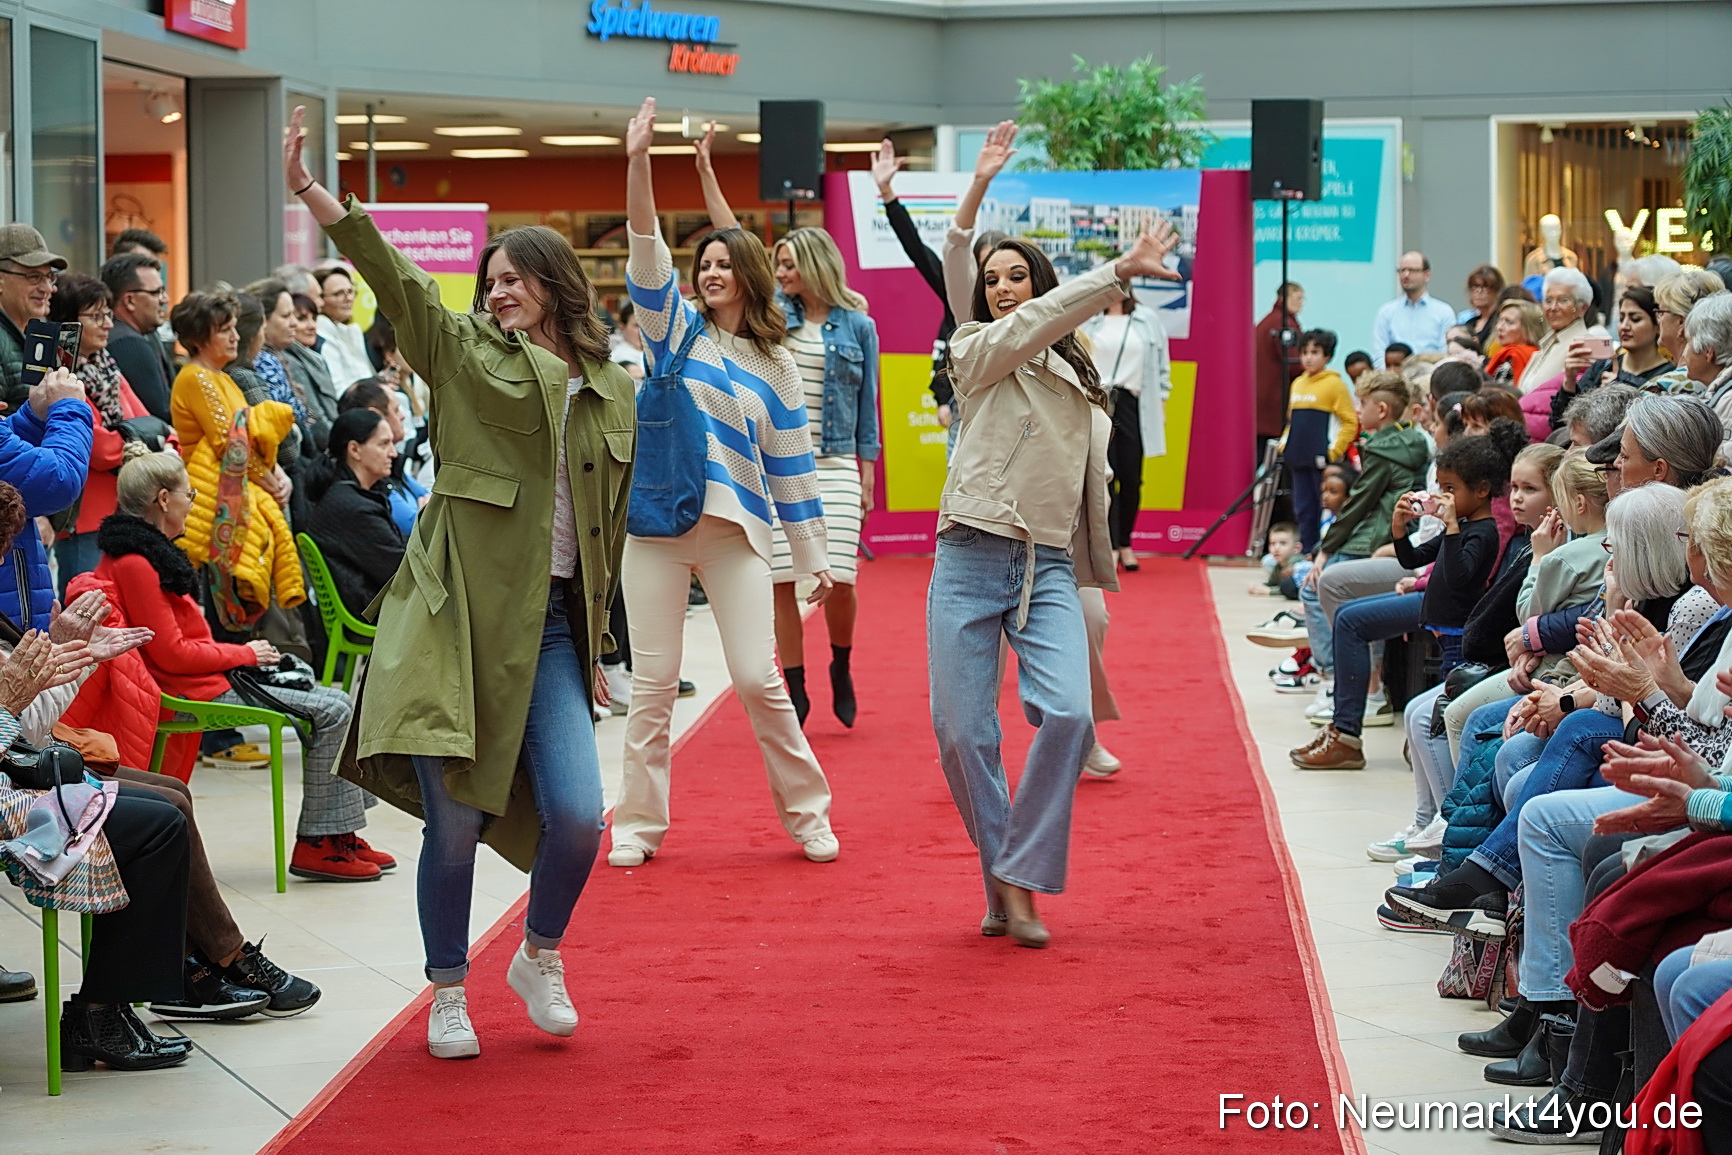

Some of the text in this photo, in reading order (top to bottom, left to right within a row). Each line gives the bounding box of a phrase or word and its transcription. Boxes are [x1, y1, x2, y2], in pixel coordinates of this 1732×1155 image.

[587, 0, 721, 41] Spielwaren
[669, 43, 739, 75] Krömer
[448, 227, 474, 245] Sie
[1604, 208, 1713, 252] VE
[919, 430, 947, 445] und
